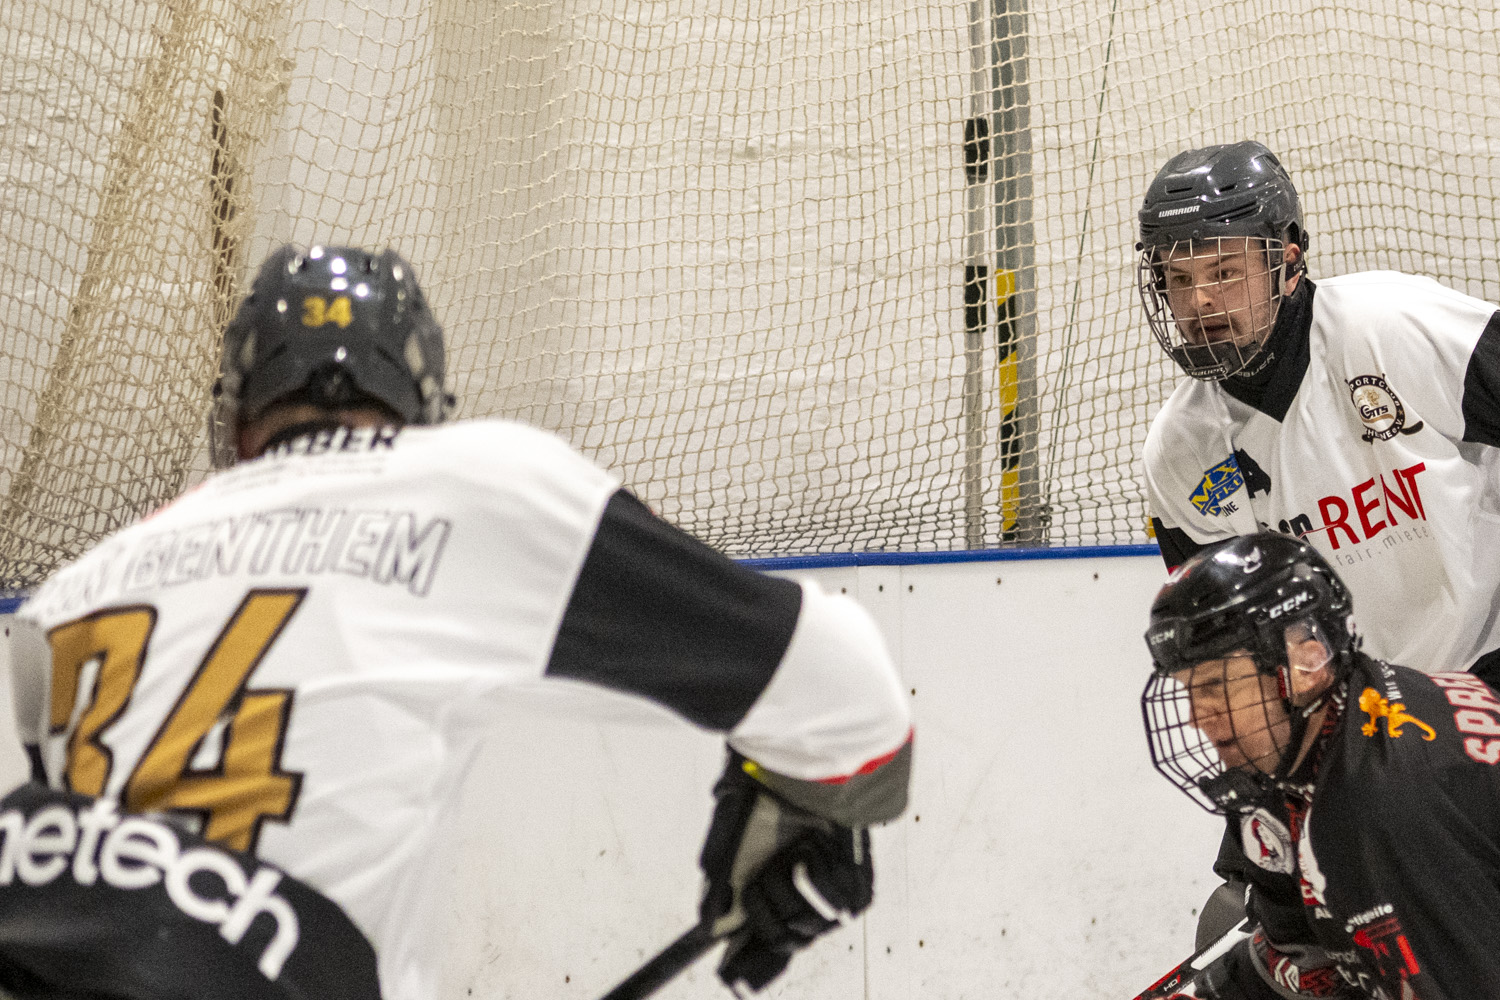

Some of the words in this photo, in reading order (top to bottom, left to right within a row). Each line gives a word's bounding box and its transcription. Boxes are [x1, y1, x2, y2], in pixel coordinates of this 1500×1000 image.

[1158, 204, 1201, 218] WARRIOR
[302, 296, 353, 328] 34
[1349, 376, 1402, 407] PORTCLUB
[124, 506, 452, 598] BENTHEM
[1269, 591, 1308, 619] CCM
[47, 587, 313, 856] 34
